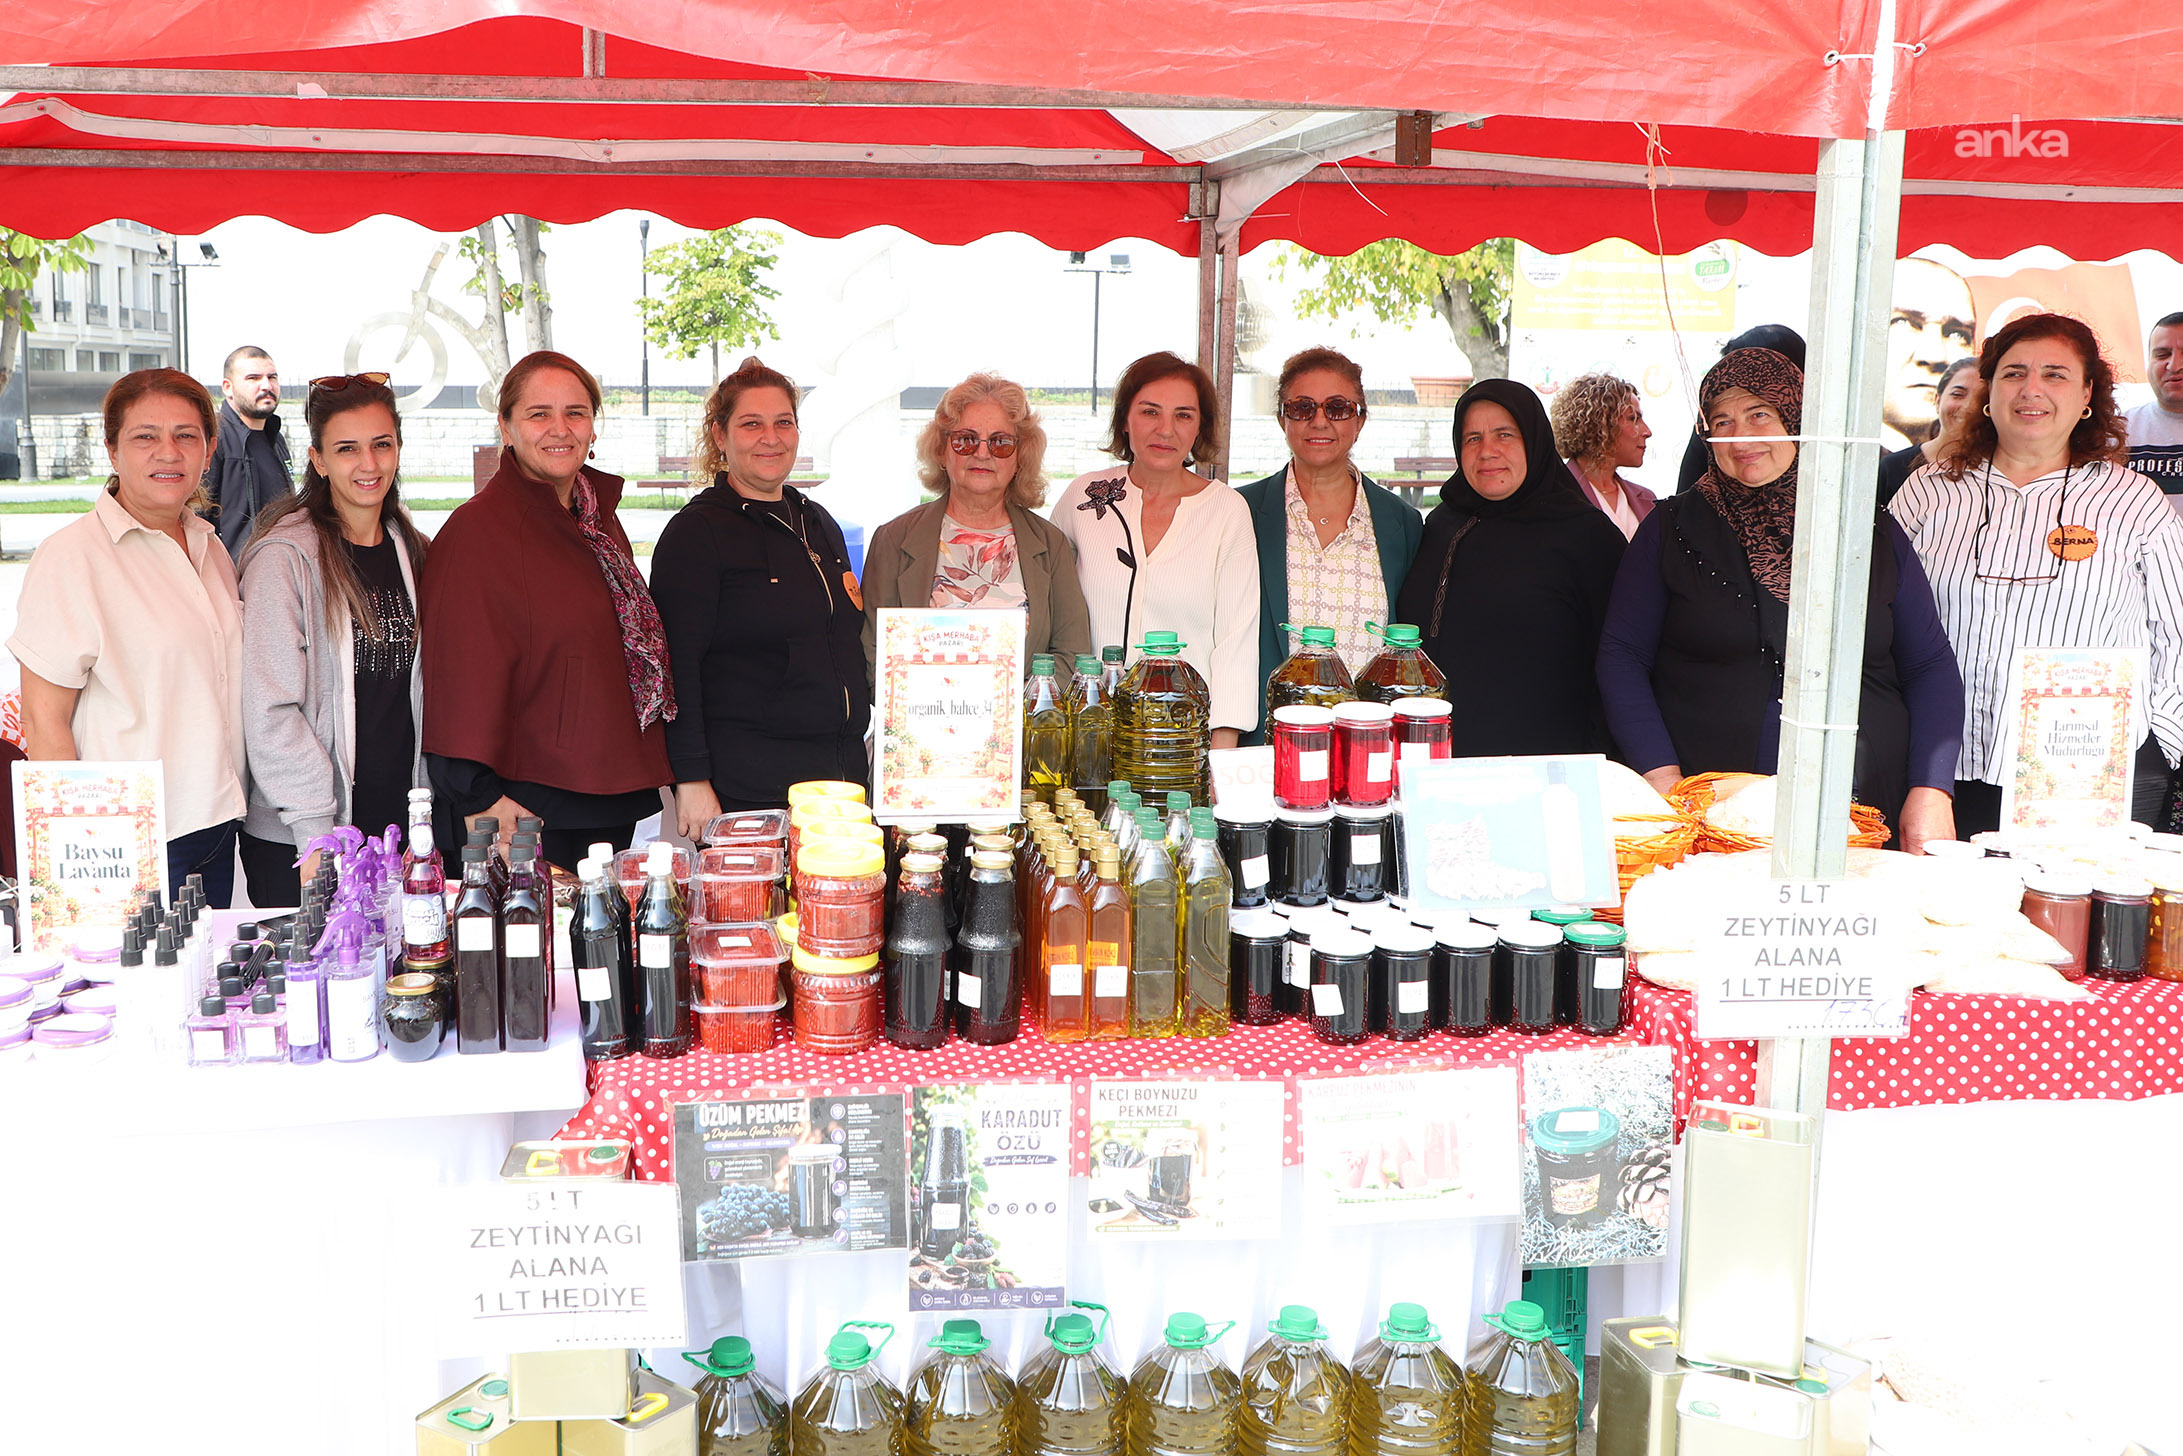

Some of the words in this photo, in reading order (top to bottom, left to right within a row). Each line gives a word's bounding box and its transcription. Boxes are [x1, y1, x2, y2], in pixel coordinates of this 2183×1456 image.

[2128, 459, 2183, 474] PROFES
[2053, 537, 2094, 546] BERNA
[923, 632, 941, 643] KIŞA
[943, 631, 980, 642] MERHABA
[2048, 732, 2102, 744] Hizmetler
[65, 843, 123, 863] Baysu
[59, 862, 131, 879] Lavanta
[1779, 885, 1791, 904] 5
[1800, 884, 1831, 904] LT
[1724, 912, 1878, 937] ZEYTİNYAĞI
[1754, 947, 1842, 966] ALANA
[1721, 978, 1730, 997] 1
[1742, 978, 1771, 997] LT
[1780, 972, 1873, 996] HEDİYE
[1099, 1086, 1129, 1103] KEÇİ
[1134, 1087, 1198, 1101] BOYNUZU
[699, 1102, 742, 1127] ÜZÜM
[981, 1109, 1063, 1128] KARADUT
[1119, 1102, 1178, 1117] PEKMEZİ
[997, 1130, 1041, 1151] ÖZÜ
[527, 1191, 541, 1211] 5
[509, 1256, 609, 1279] ALANA
[474, 1293, 484, 1312] 1
[498, 1290, 531, 1311] LT
[542, 1282, 647, 1309] HEDİYE
